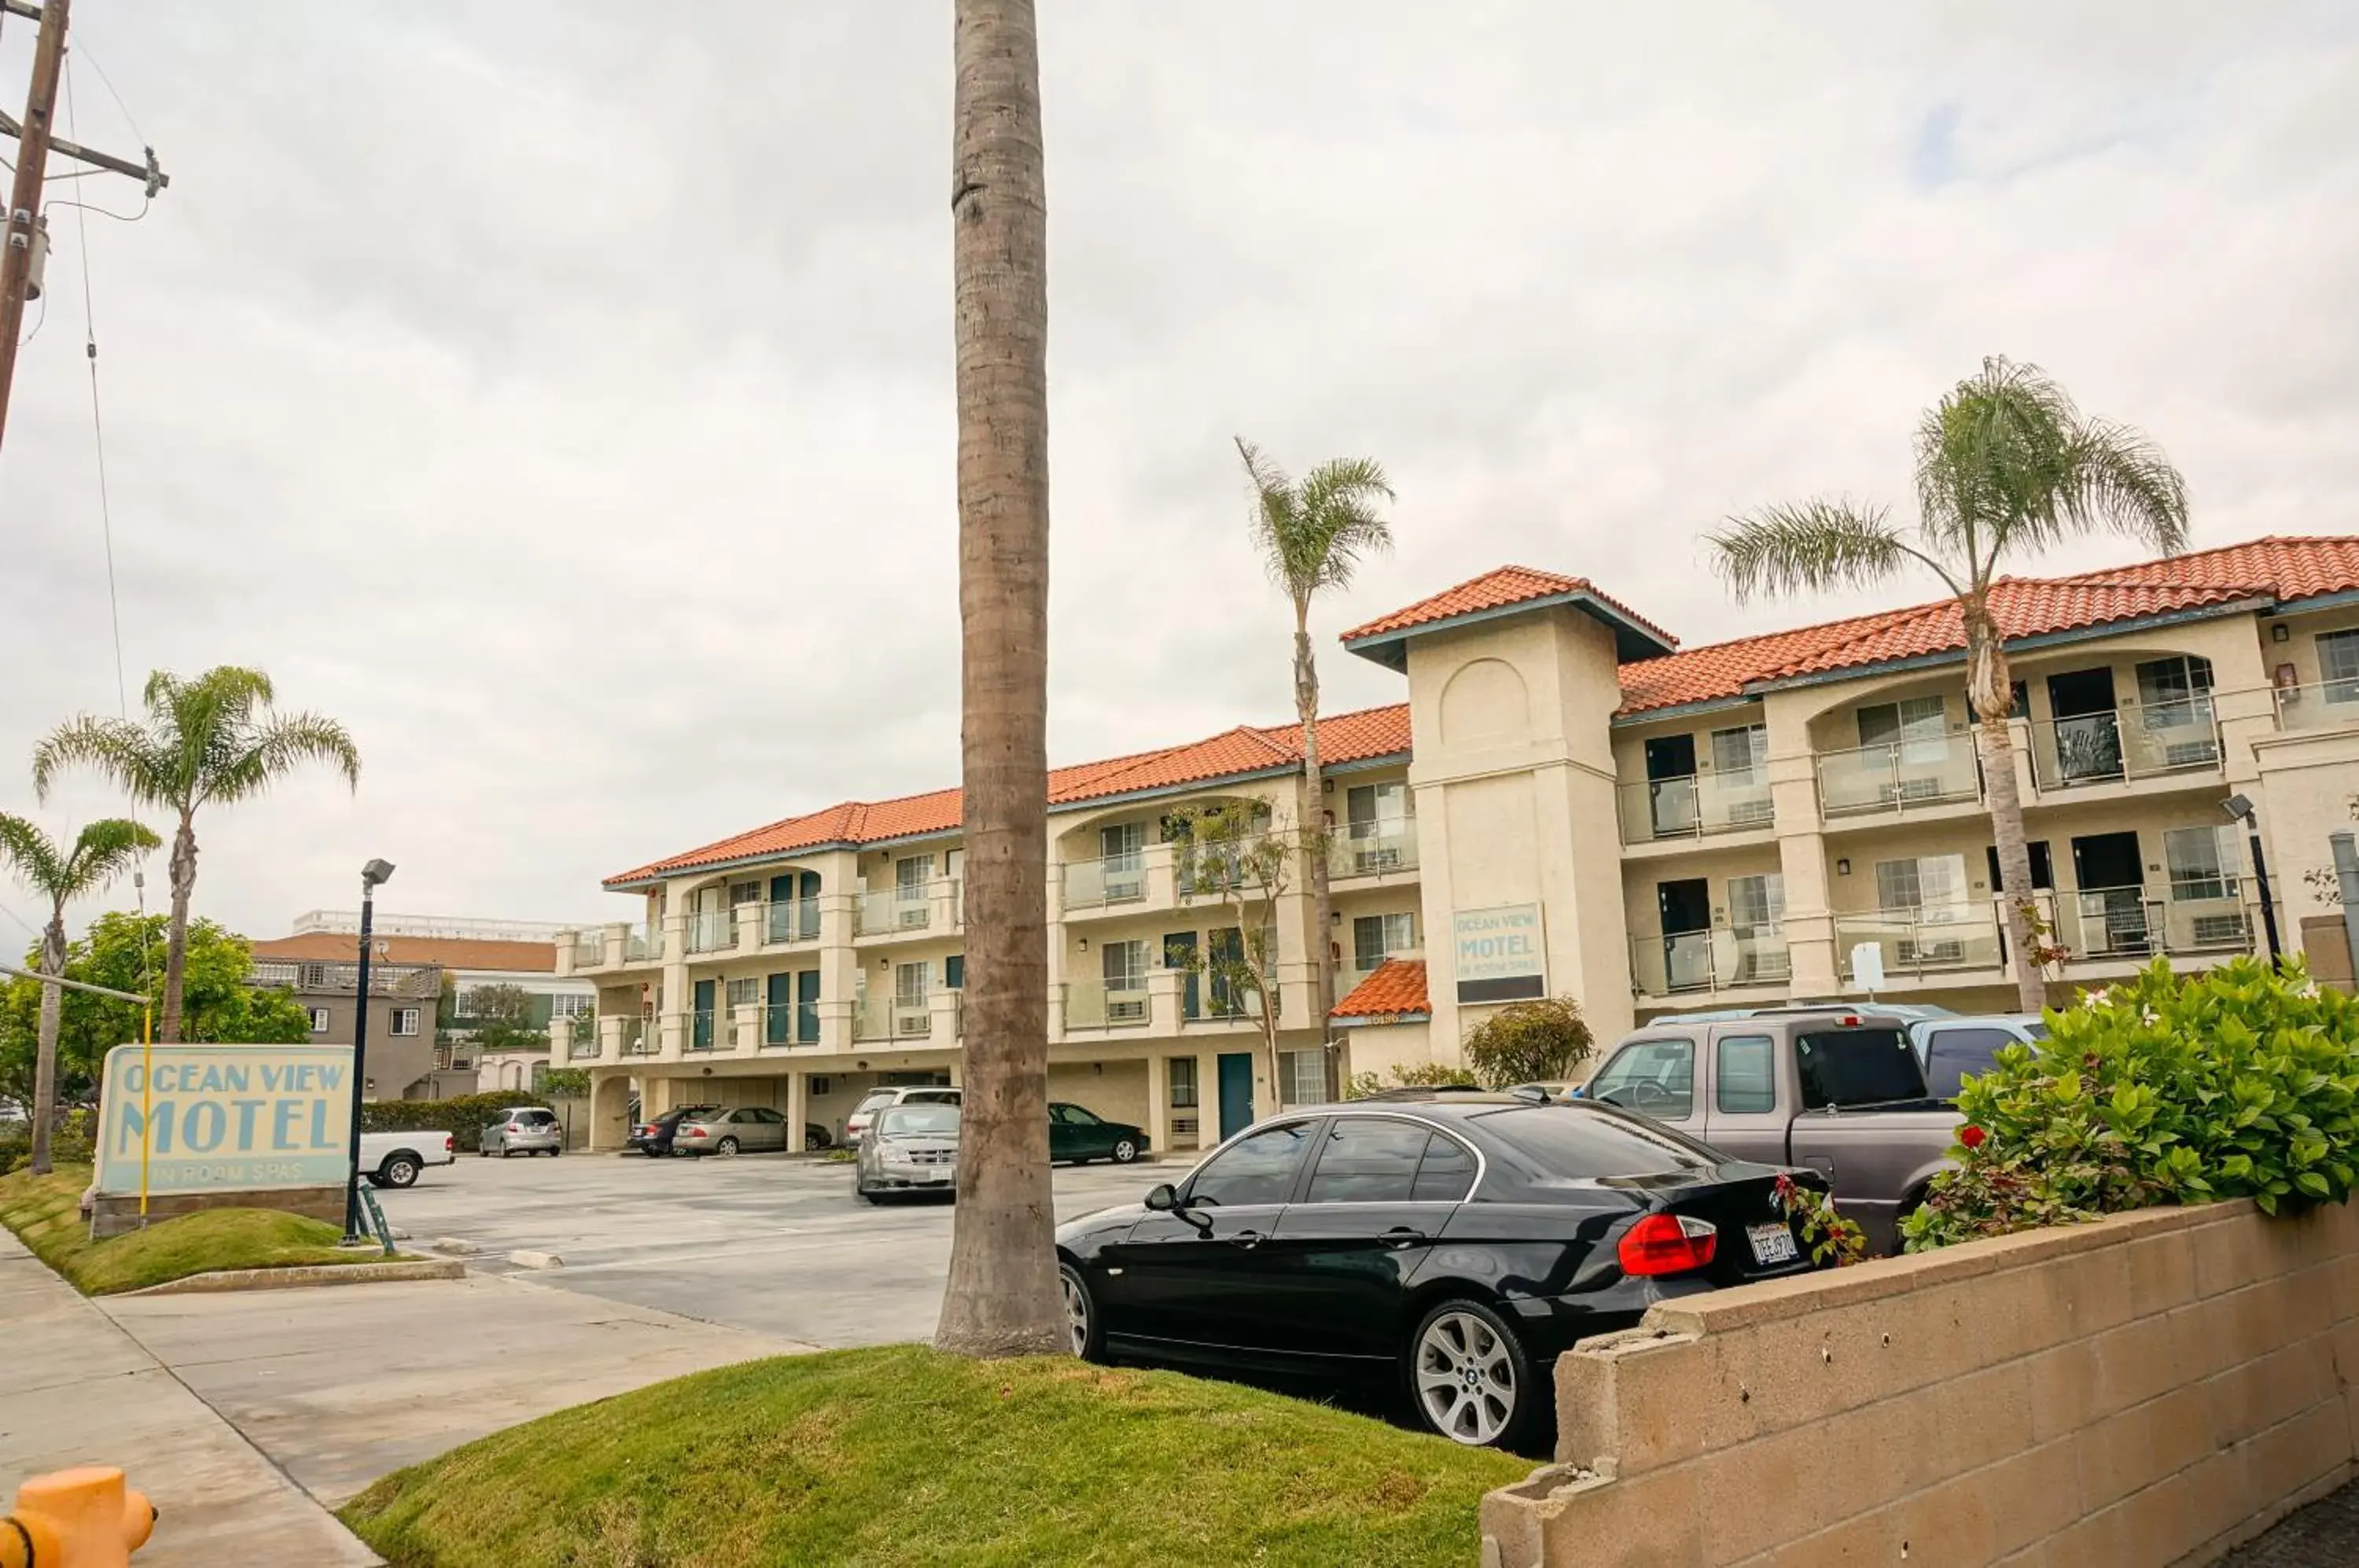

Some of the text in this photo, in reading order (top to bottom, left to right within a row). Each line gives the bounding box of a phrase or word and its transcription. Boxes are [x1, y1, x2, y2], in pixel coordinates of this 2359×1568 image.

[1457, 916, 1499, 933] OCEAN
[1459, 934, 1535, 959] MOTEL
[123, 1064, 345, 1093] OCEAN VIEW
[119, 1099, 339, 1155] MOTEL
[183, 1164, 244, 1181] ROOM
[253, 1161, 304, 1180] SPAS
